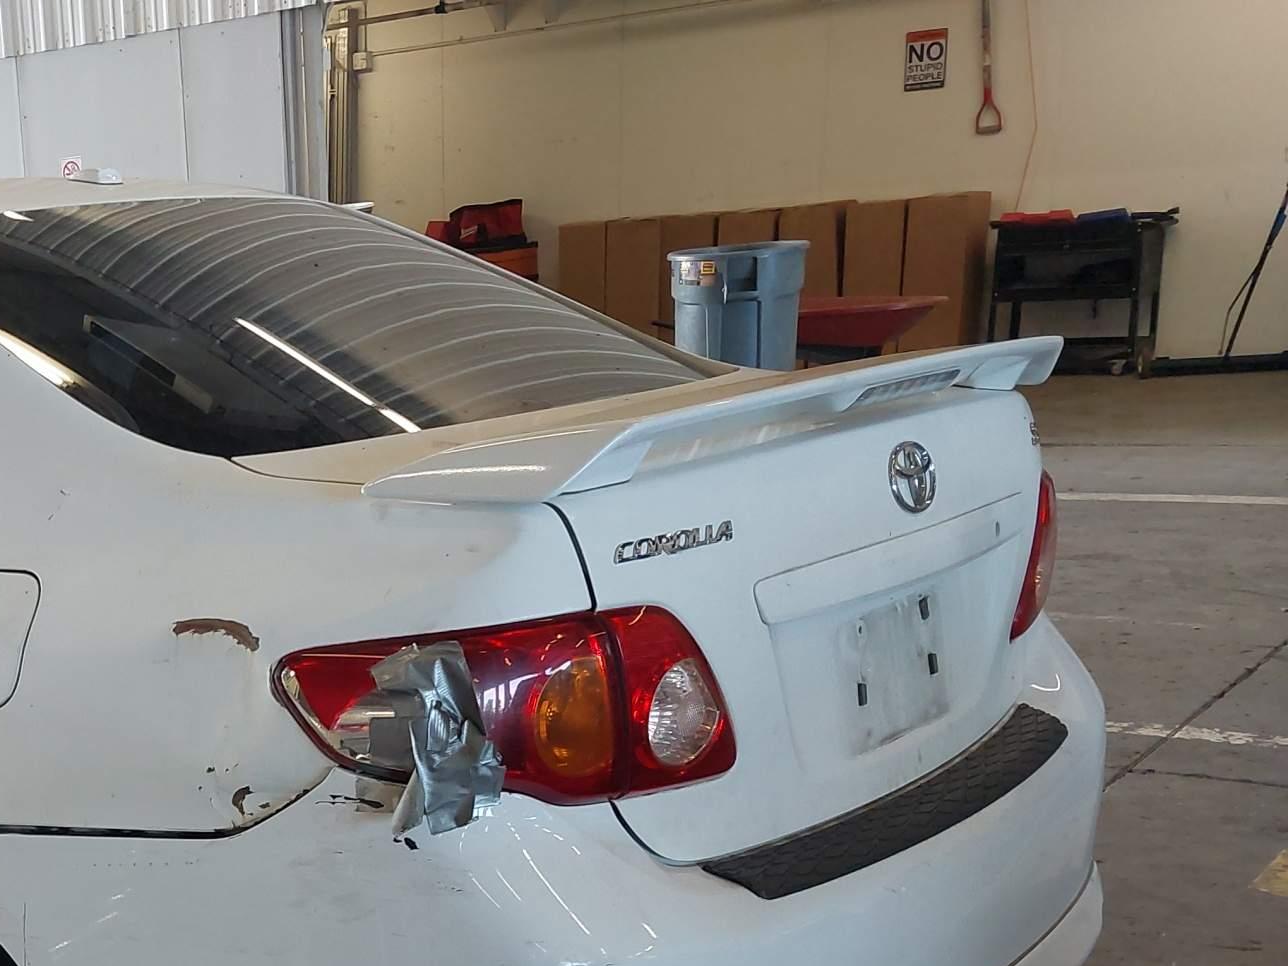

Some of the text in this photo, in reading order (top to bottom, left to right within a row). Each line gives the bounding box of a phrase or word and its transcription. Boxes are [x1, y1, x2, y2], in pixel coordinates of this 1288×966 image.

[909, 41, 944, 63] NO
[907, 62, 943, 73] STUPID
[907, 71, 942, 82] PEOPLE
[613, 520, 733, 564] COROLLA
